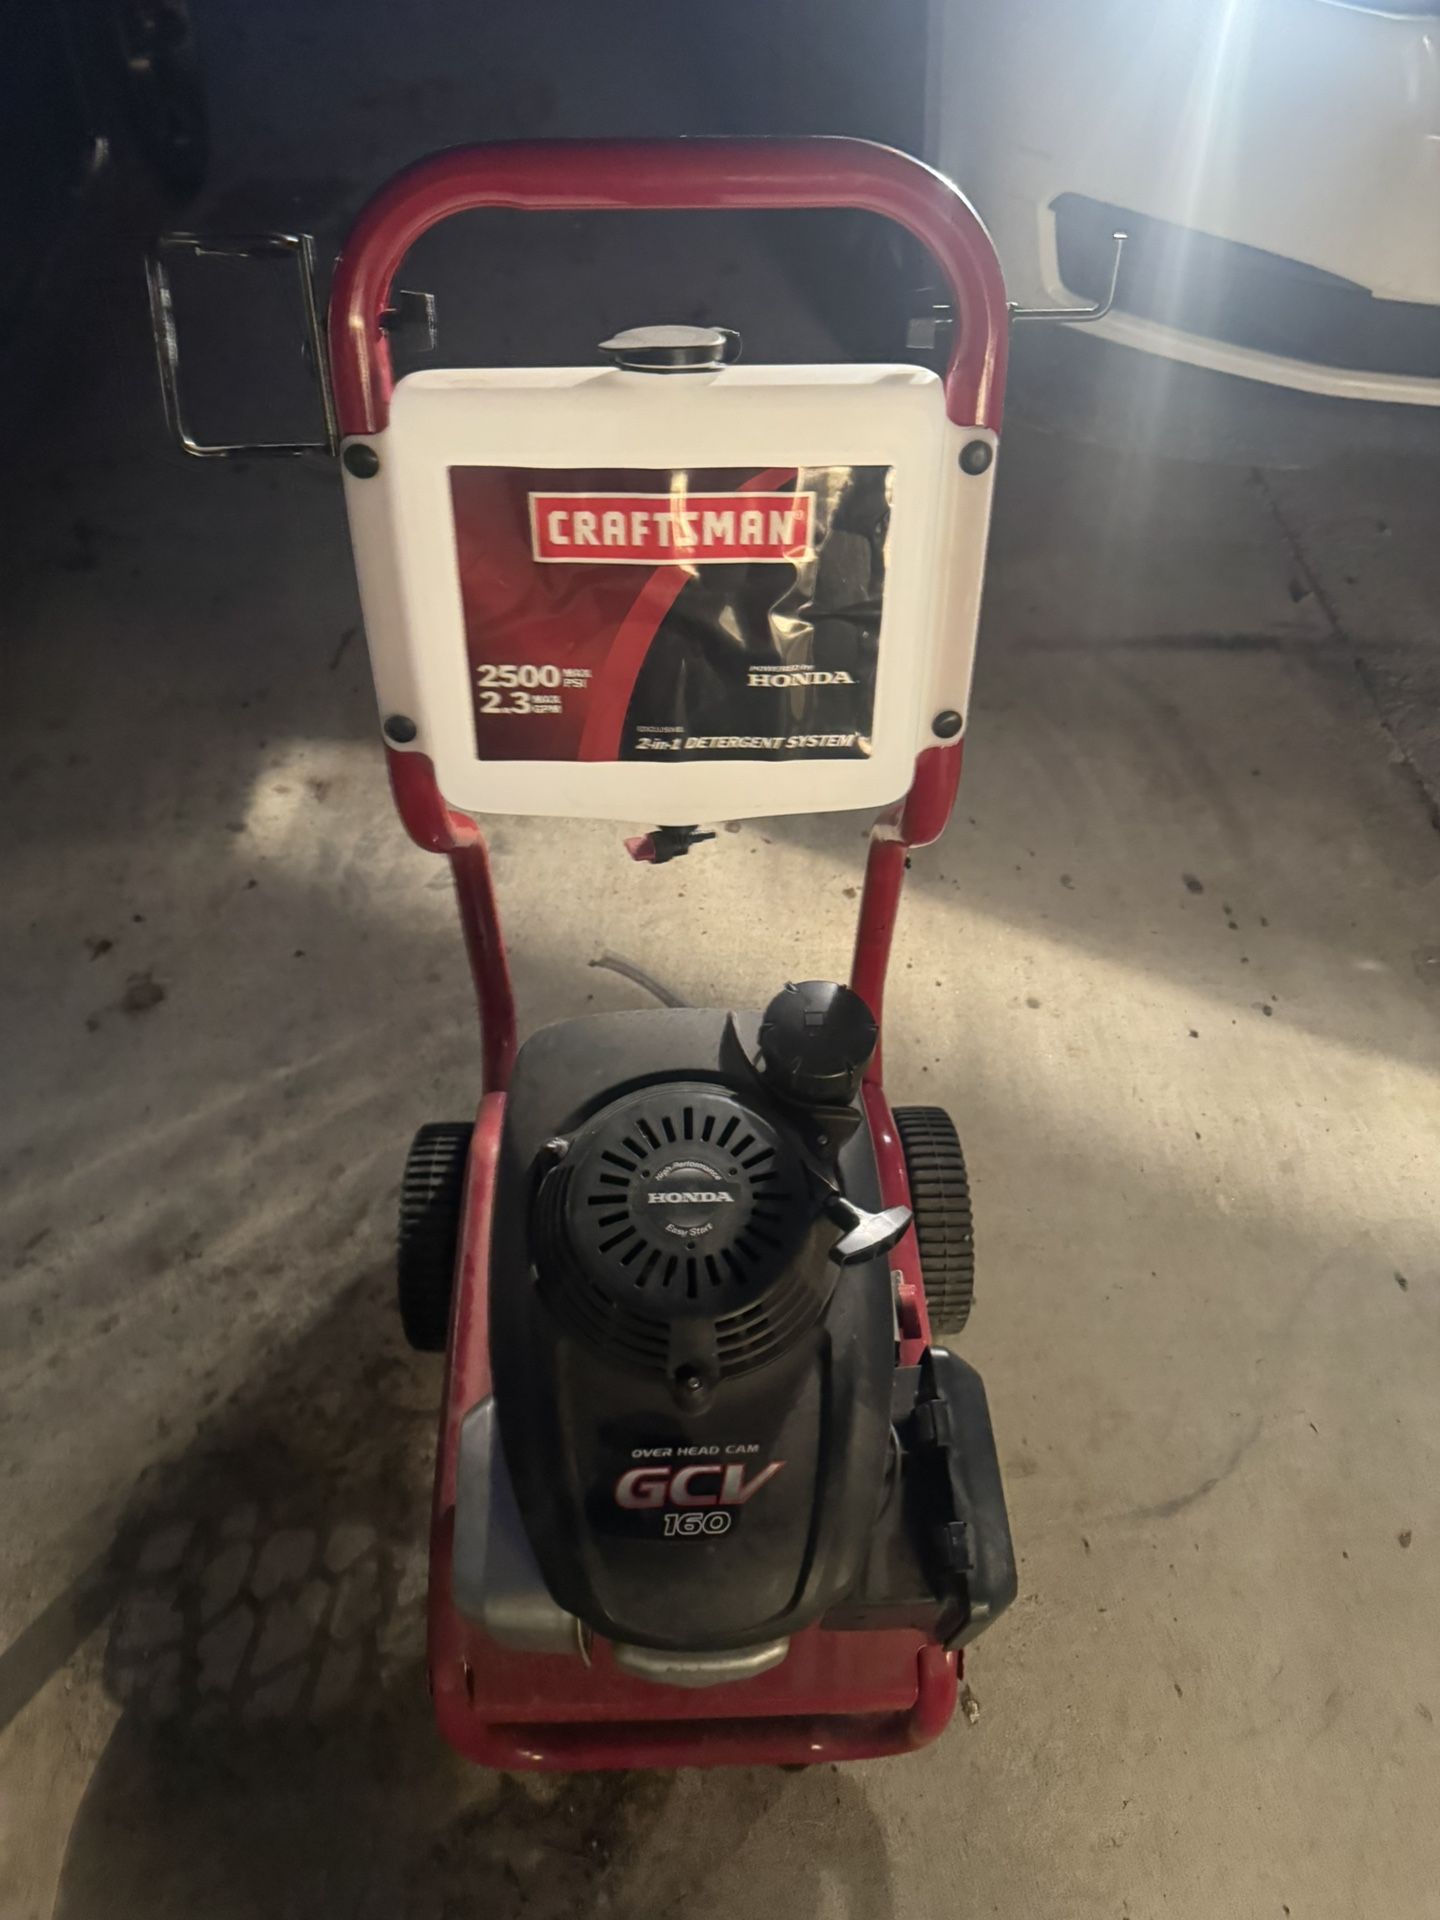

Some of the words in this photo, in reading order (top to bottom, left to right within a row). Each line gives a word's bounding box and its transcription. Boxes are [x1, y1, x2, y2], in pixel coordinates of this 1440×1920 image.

[548, 510, 793, 547] CRAFTSMAN
[477, 664, 561, 688] 2500
[747, 671, 856, 688] HONDA
[479, 691, 531, 714] 2.3
[635, 737, 682, 750] 2-in-1
[684, 735, 786, 750] DETERGENT
[785, 734, 856, 748] SYSTEM
[647, 1191, 735, 1204] HONDA
[664, 1223, 688, 1237] Easy
[688, 1222, 713, 1237] Start
[631, 1447, 673, 1459] OVER
[676, 1446, 720, 1457] HEAD
[725, 1444, 761, 1454] CAM
[614, 1460, 787, 1510] GCV
[663, 1511, 732, 1537] 160
